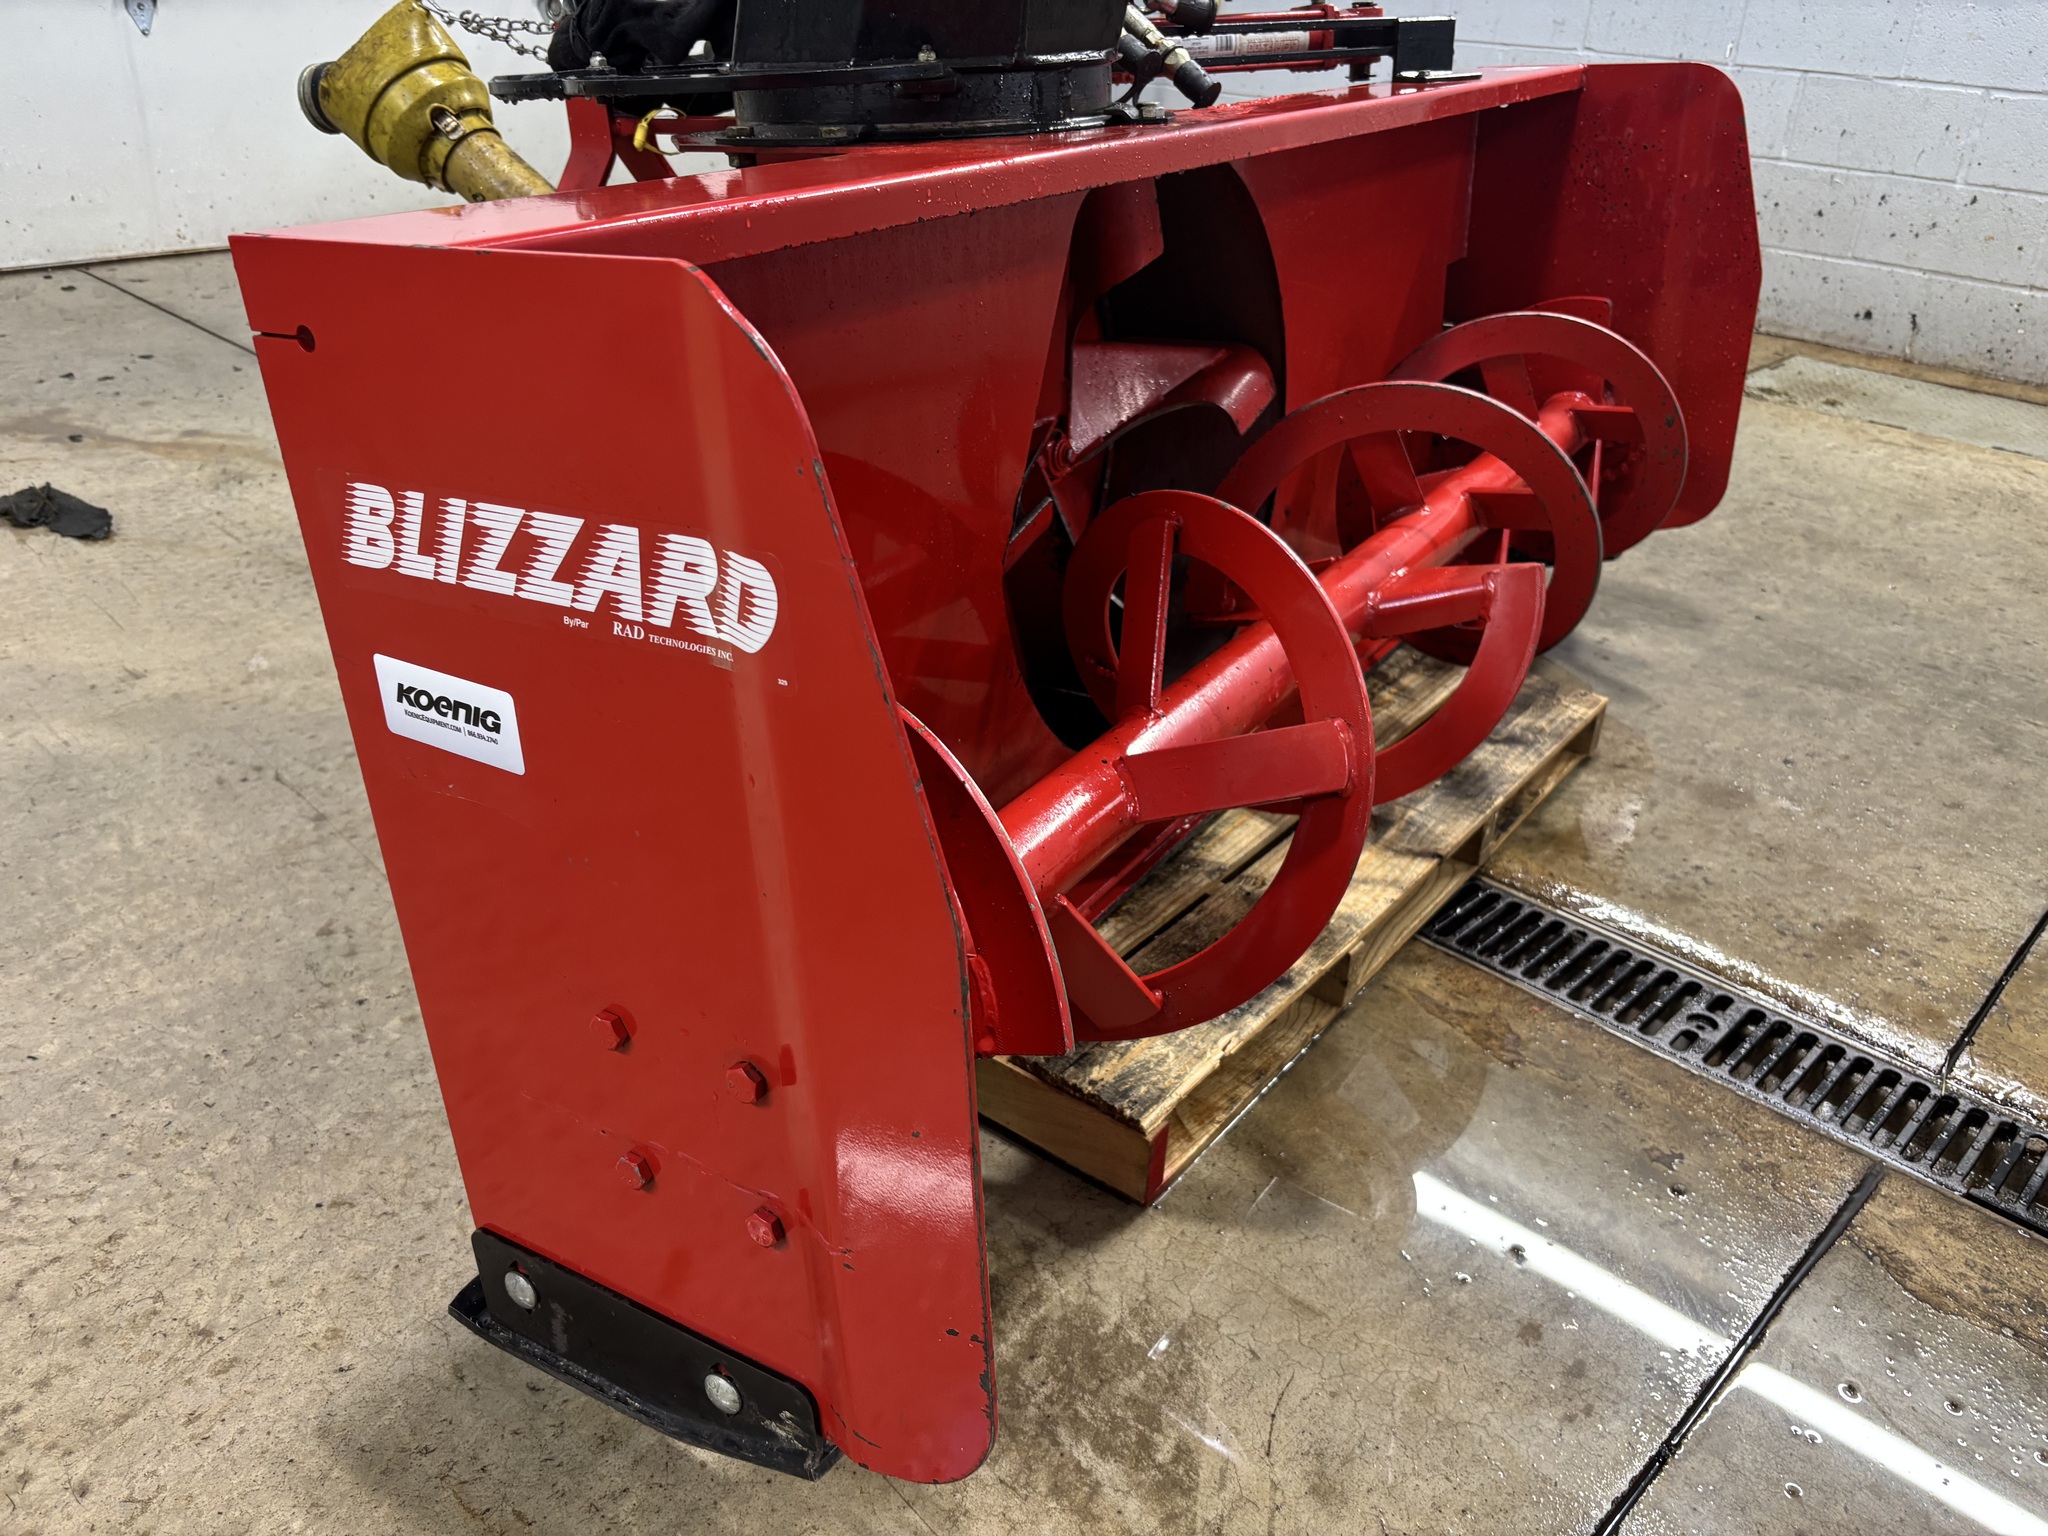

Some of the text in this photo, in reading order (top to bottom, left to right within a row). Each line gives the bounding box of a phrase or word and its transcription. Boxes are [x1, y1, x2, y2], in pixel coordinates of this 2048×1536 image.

[341, 482, 779, 654] BLIZZARD
[563, 615, 589, 629] By/Par
[613, 621, 734, 662] RAD TECHNOLOGIES INC.
